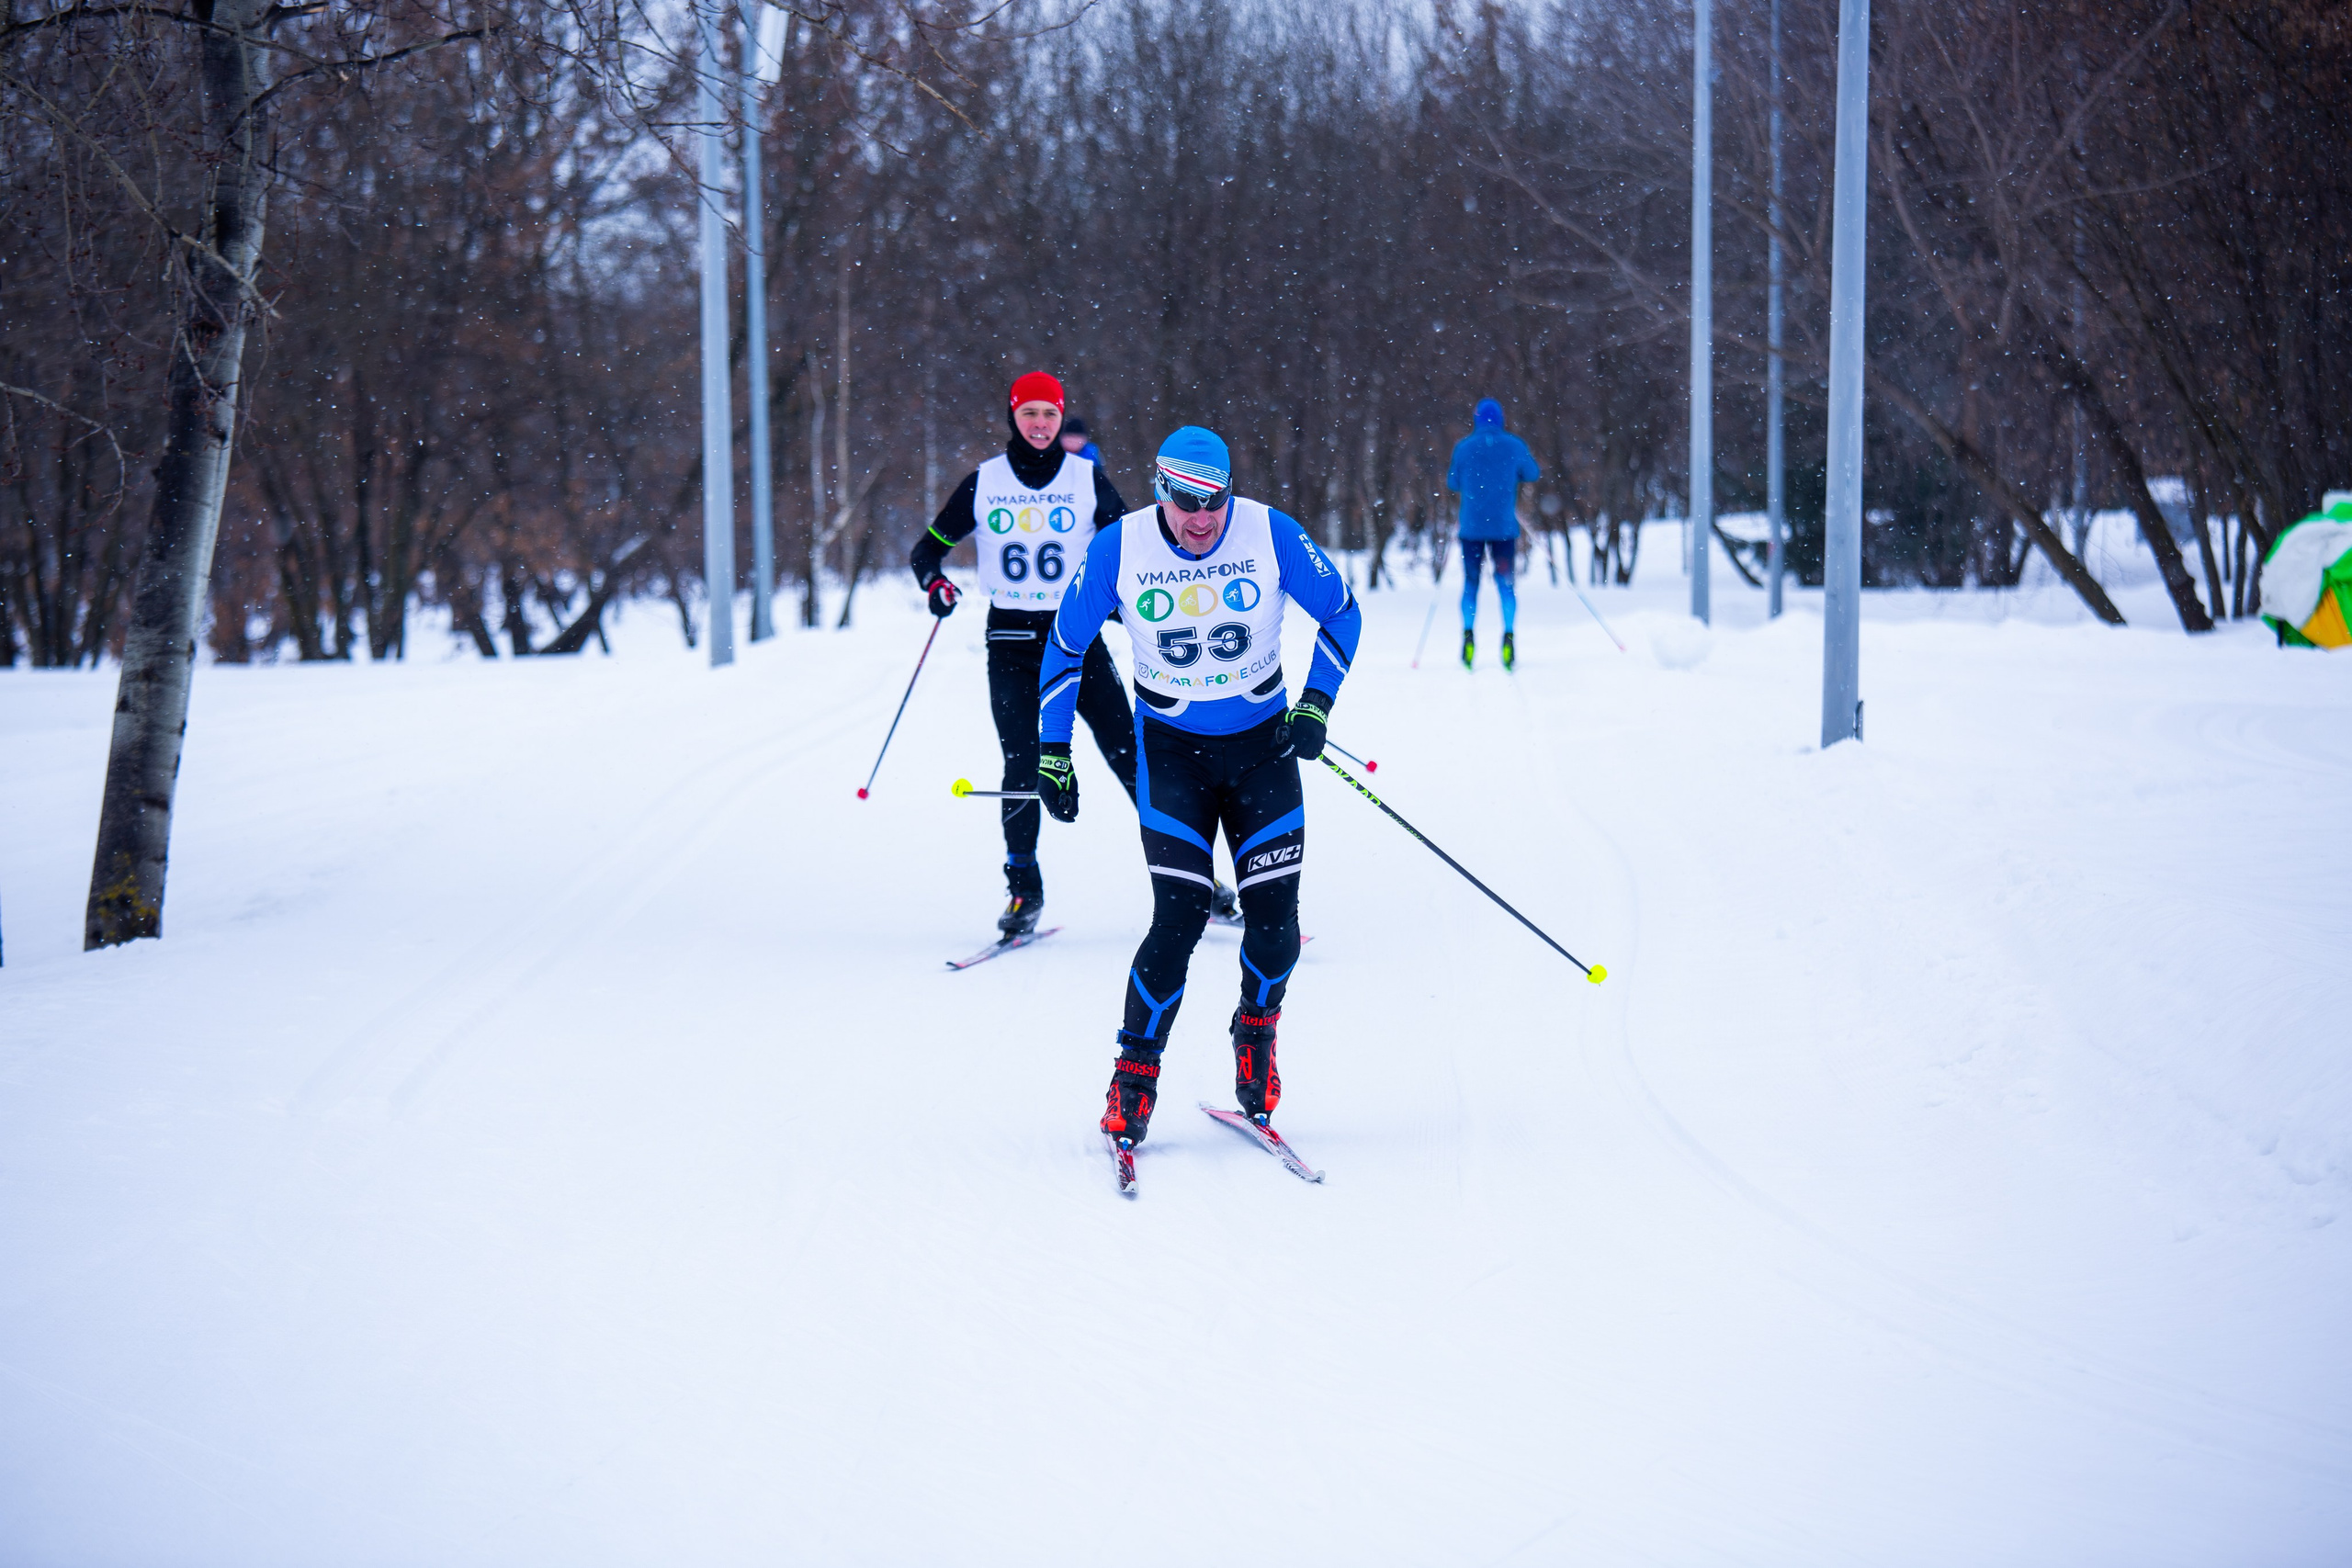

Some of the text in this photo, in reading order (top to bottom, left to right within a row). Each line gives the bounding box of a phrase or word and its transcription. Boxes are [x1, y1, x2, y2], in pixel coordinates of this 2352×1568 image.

[987, 493, 1075, 505] VMARAFONE
[999, 540, 1066, 583] 66
[1136, 559, 1257, 585] VMARAFONE
[1157, 622, 1252, 668] 53
[1149, 649, 1277, 687] VMARAFONE.CLUB
[1248, 844, 1302, 873] KV+
